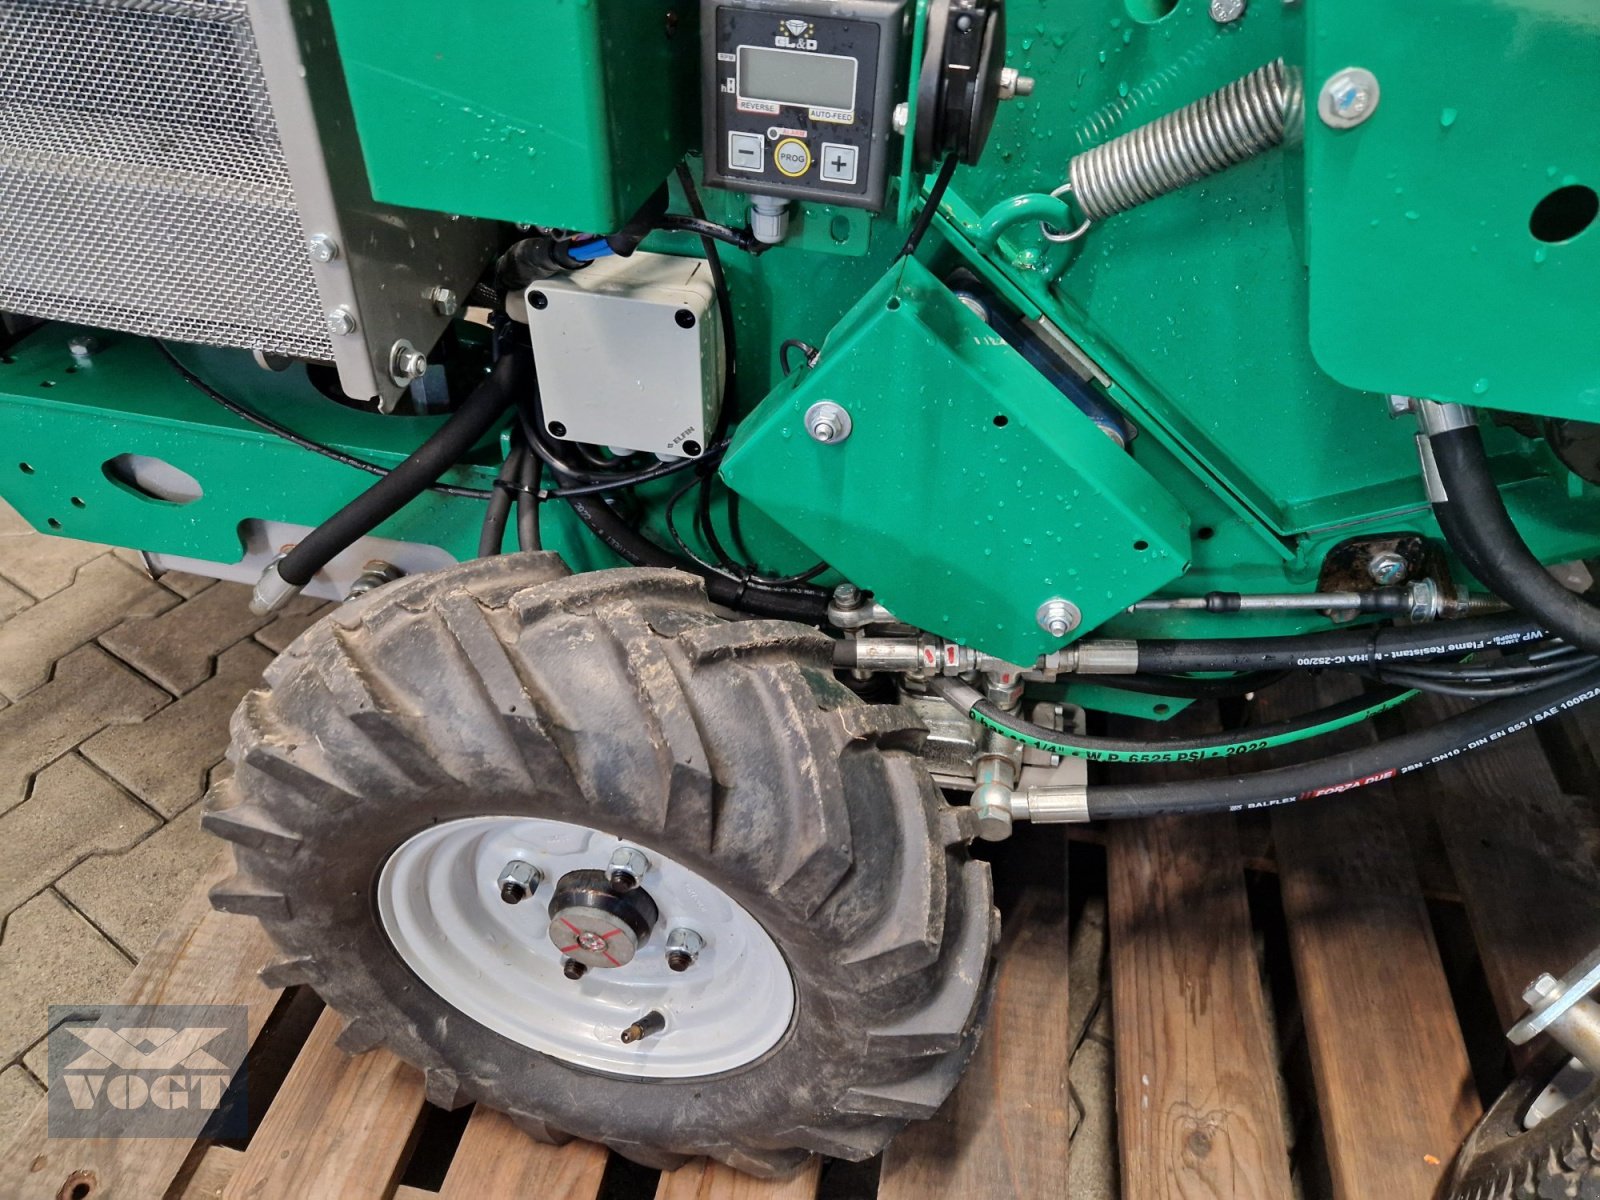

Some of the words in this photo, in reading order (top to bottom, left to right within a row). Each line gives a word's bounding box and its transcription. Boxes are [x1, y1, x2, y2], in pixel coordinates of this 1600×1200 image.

[740, 102, 775, 113] REVERSE
[810, 110, 853, 121] AUTO-FEED
[780, 152, 805, 163] PROG
[673, 426, 695, 444] ELFIN
[1522, 630, 1543, 641] WP
[1448, 640, 1484, 652] Flame
[1391, 645, 1446, 659] Resistant
[1297, 655, 1346, 666] IC-252/00
[1128, 753, 1172, 763] 6525
[1176, 750, 1206, 763] PSI
[1226, 741, 1268, 756] 2022
[1247, 796, 1297, 809] BALFLEX
[1315, 781, 1361, 797] FORZA
[1364, 771, 1394, 785] DUE
[1431, 748, 1461, 764] DN10
[1467, 737, 1489, 750] DIN
[1490, 730, 1507, 742] EN
[1534, 706, 1560, 723] SAE
